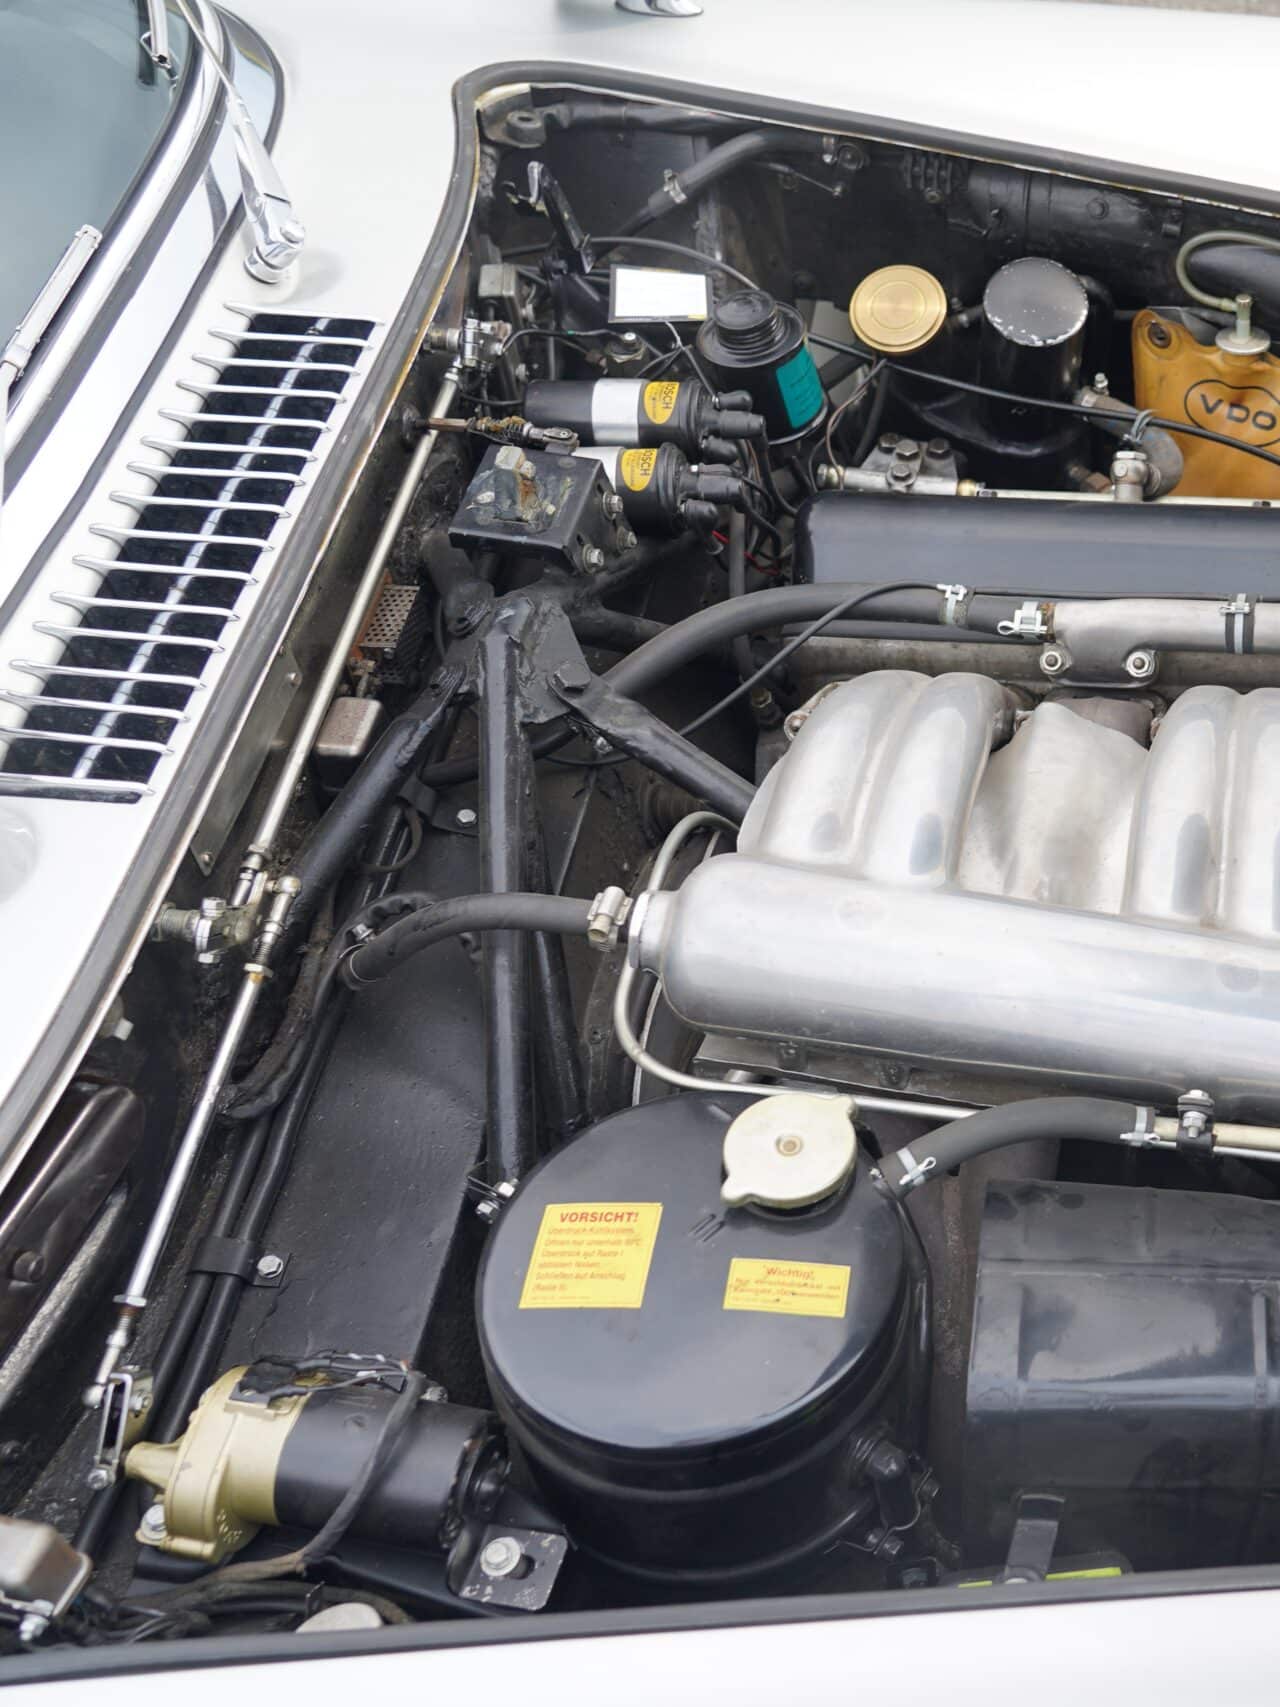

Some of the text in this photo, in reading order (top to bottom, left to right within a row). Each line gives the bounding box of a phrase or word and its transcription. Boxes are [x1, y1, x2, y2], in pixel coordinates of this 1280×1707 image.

[1200, 393, 1277, 431] VDO
[640, 448, 656, 476] OSCH
[559, 1211, 640, 1223] VORSICHT!
